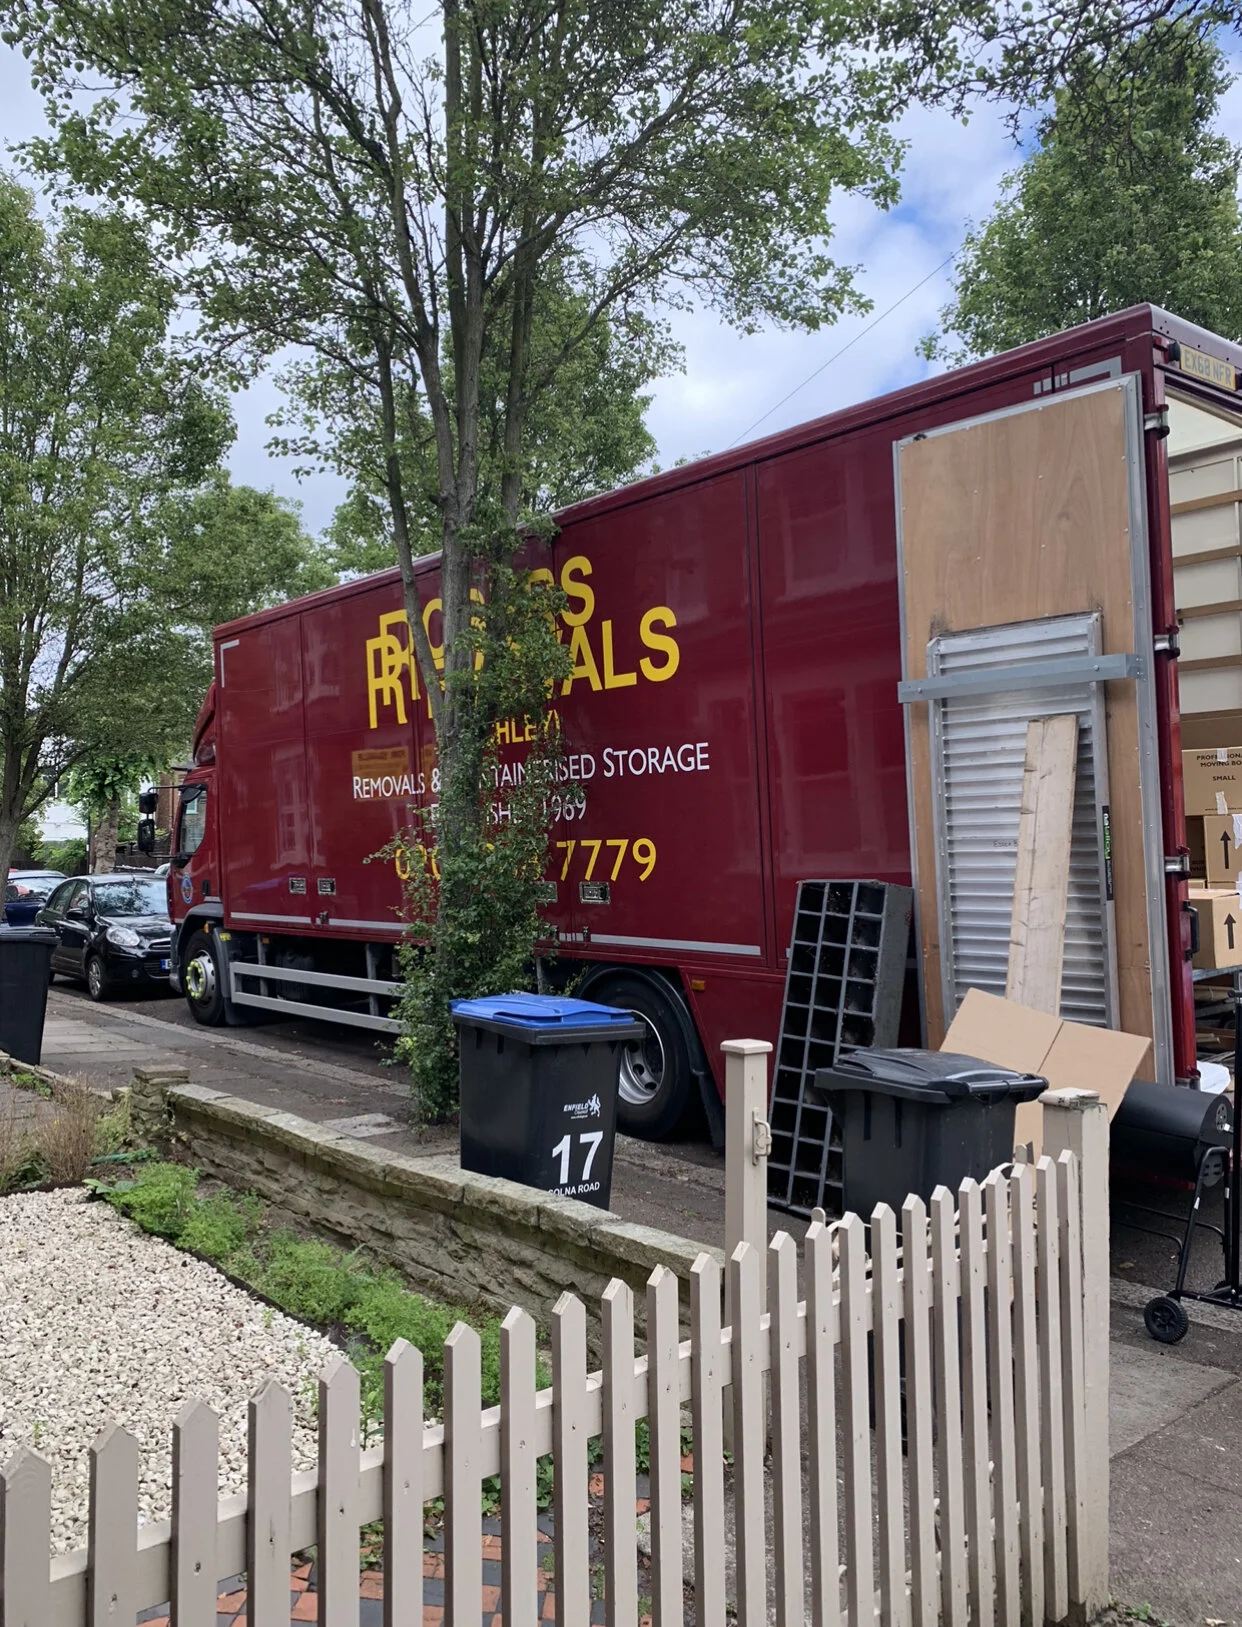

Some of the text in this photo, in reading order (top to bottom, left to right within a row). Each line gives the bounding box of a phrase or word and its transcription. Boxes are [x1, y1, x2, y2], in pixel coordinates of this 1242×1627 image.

[1212, 361, 1232, 386] NFR
[353, 772, 426, 799] REMOVALS
[431, 768, 441, 794] &
[602, 742, 710, 778] STORAGE
[556, 838, 657, 882] 7779
[563, 1102, 589, 1112] ENFIELD
[551, 1130, 604, 1184] 17
[578, 1181, 601, 1194] ROAD
